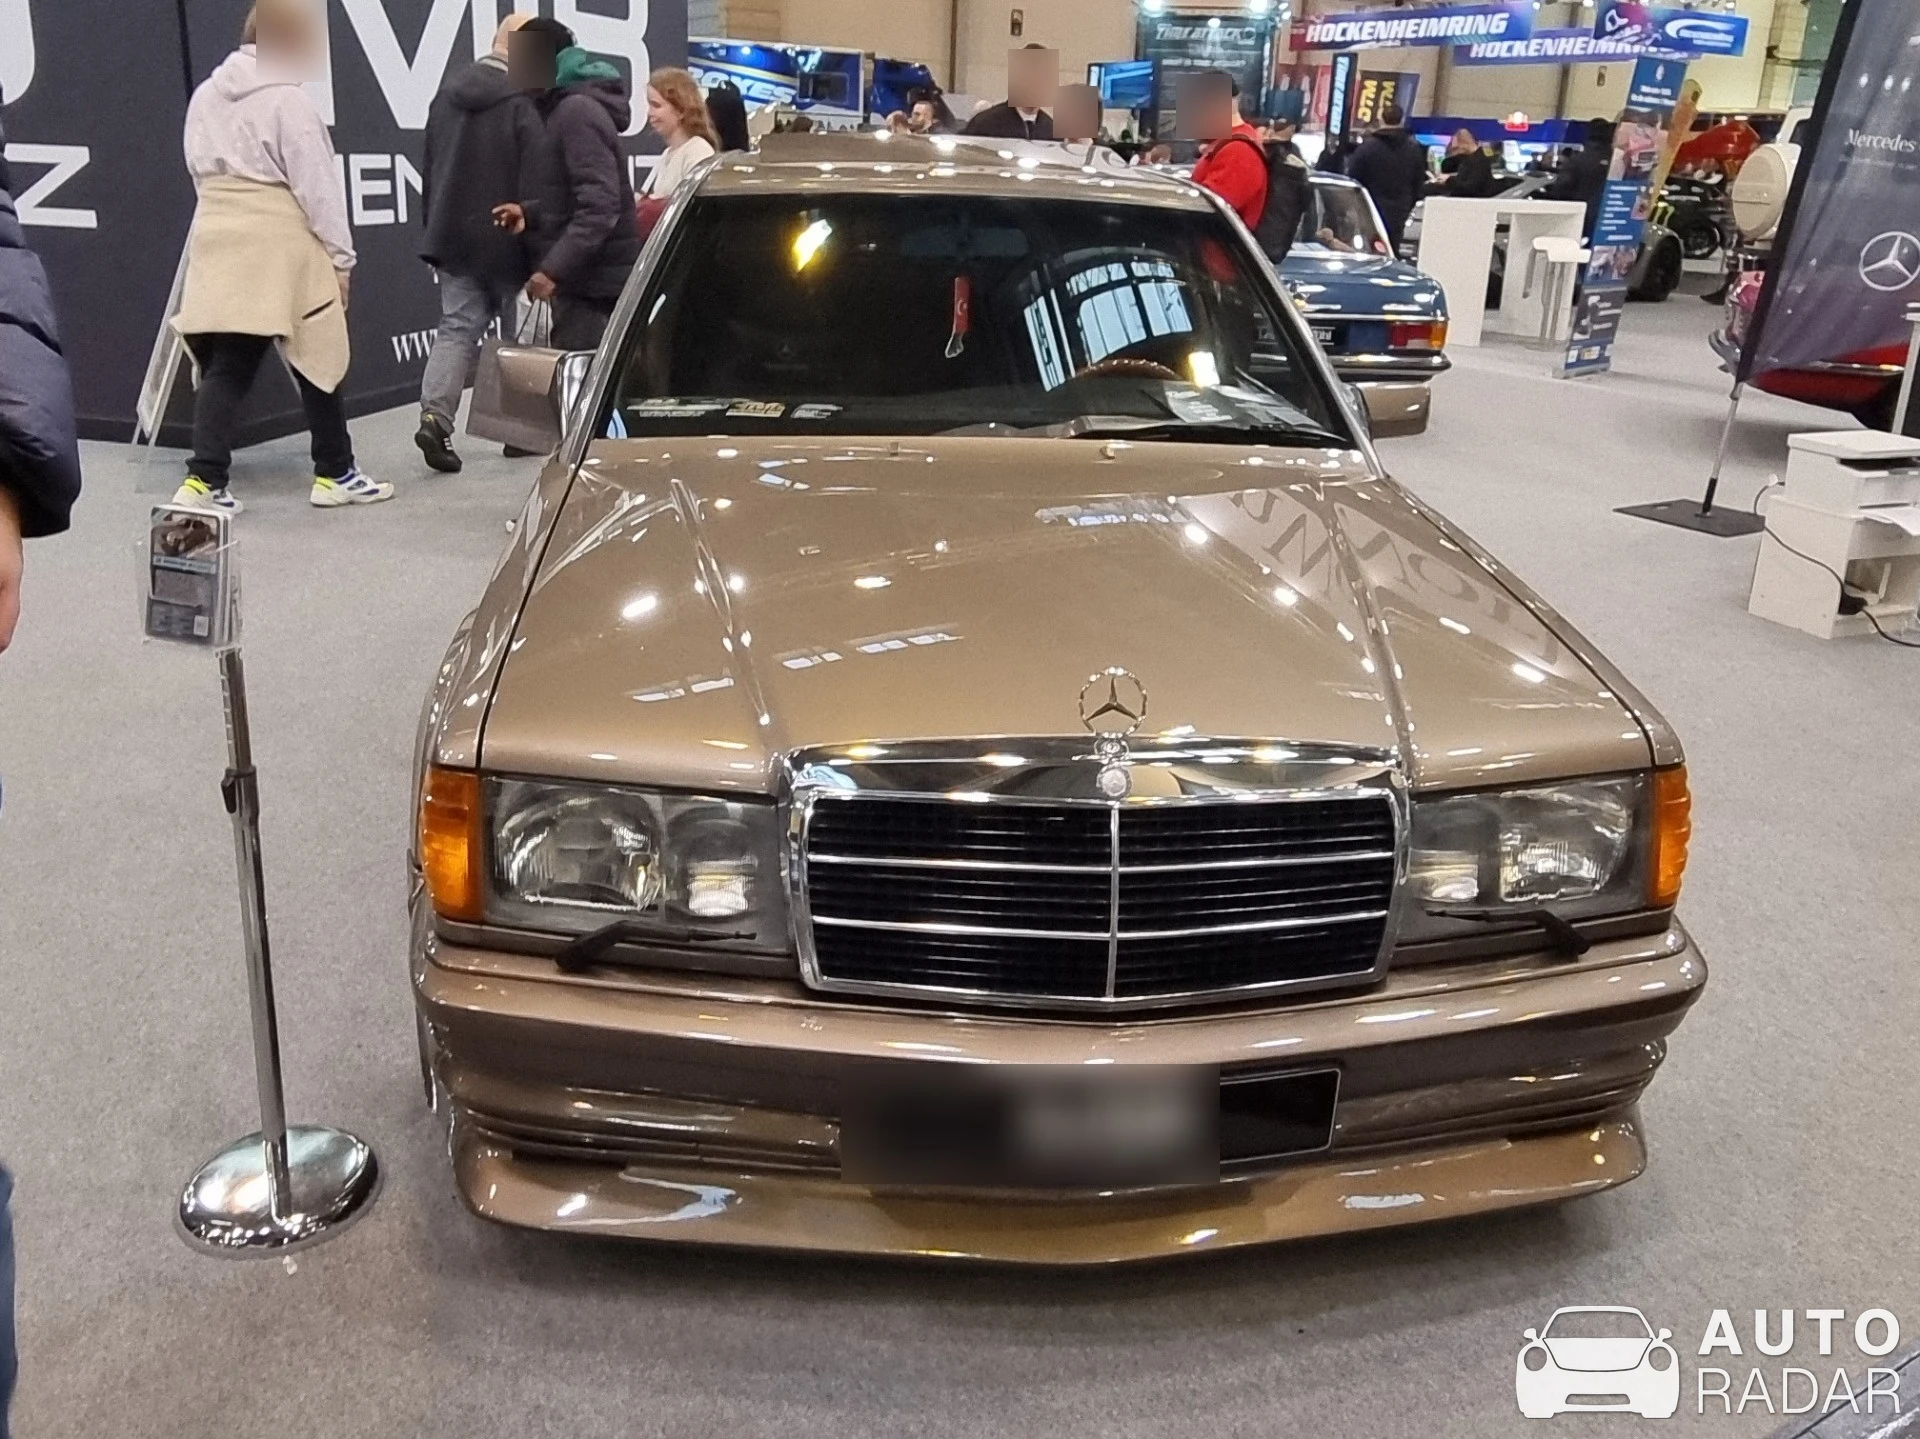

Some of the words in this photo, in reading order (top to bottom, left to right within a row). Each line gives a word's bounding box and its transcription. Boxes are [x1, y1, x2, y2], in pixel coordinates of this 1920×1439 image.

[1305, 12, 1510, 44] HOCKENHEIMRING
[1470, 36, 1675, 59] HOCKENHEIM
[1357, 79, 1378, 124] DTM
[1377, 80, 1396, 120] TM
